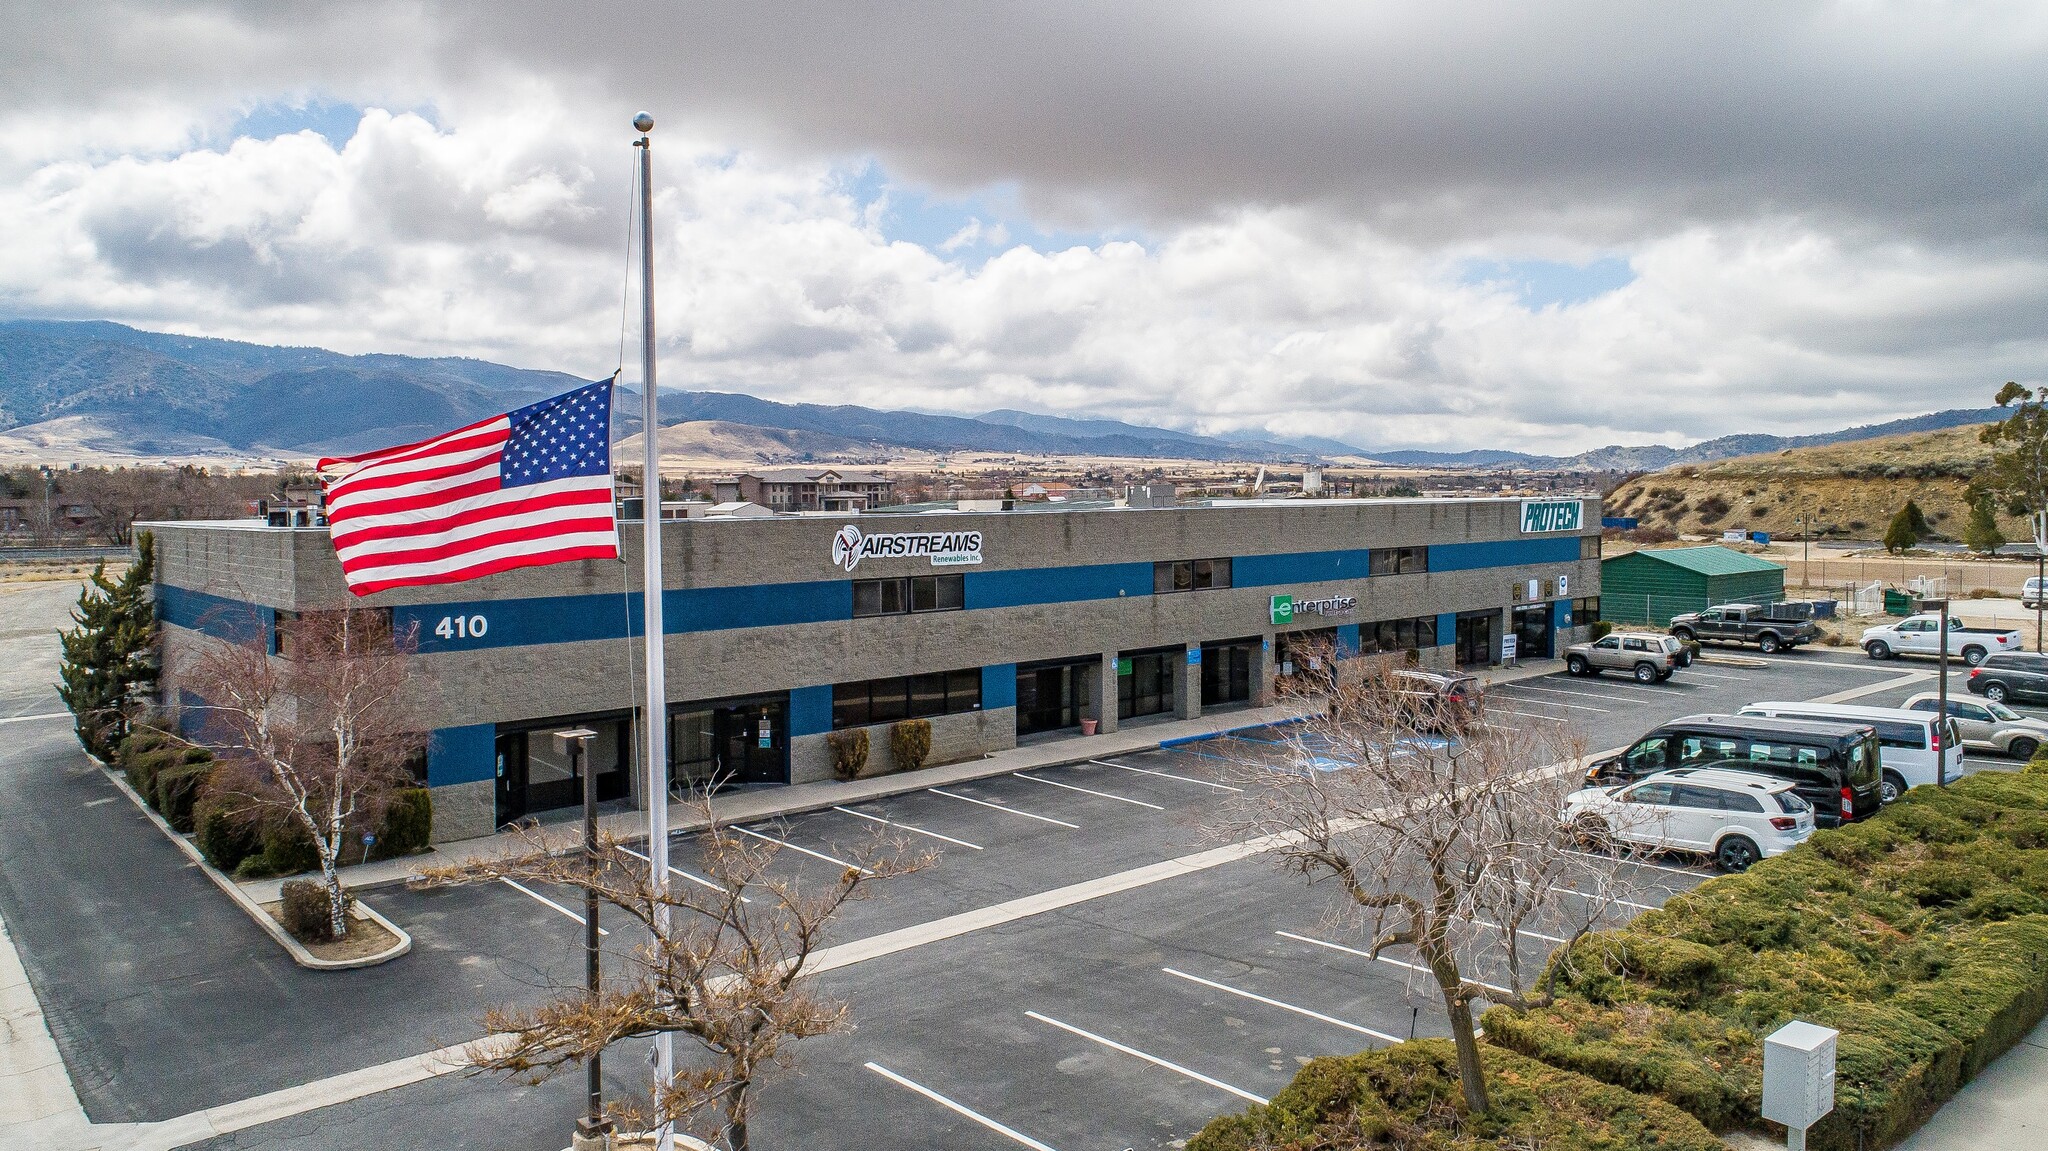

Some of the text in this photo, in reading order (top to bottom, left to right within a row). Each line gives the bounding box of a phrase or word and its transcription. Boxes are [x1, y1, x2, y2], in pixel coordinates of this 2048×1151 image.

[1523, 501, 1580, 532] PROTECH
[861, 533, 980, 556] AIRSTREAMS
[933, 553, 981, 563] Renewables Inc.
[1277, 595, 1357, 617] enterprise
[435, 615, 488, 639] 410
